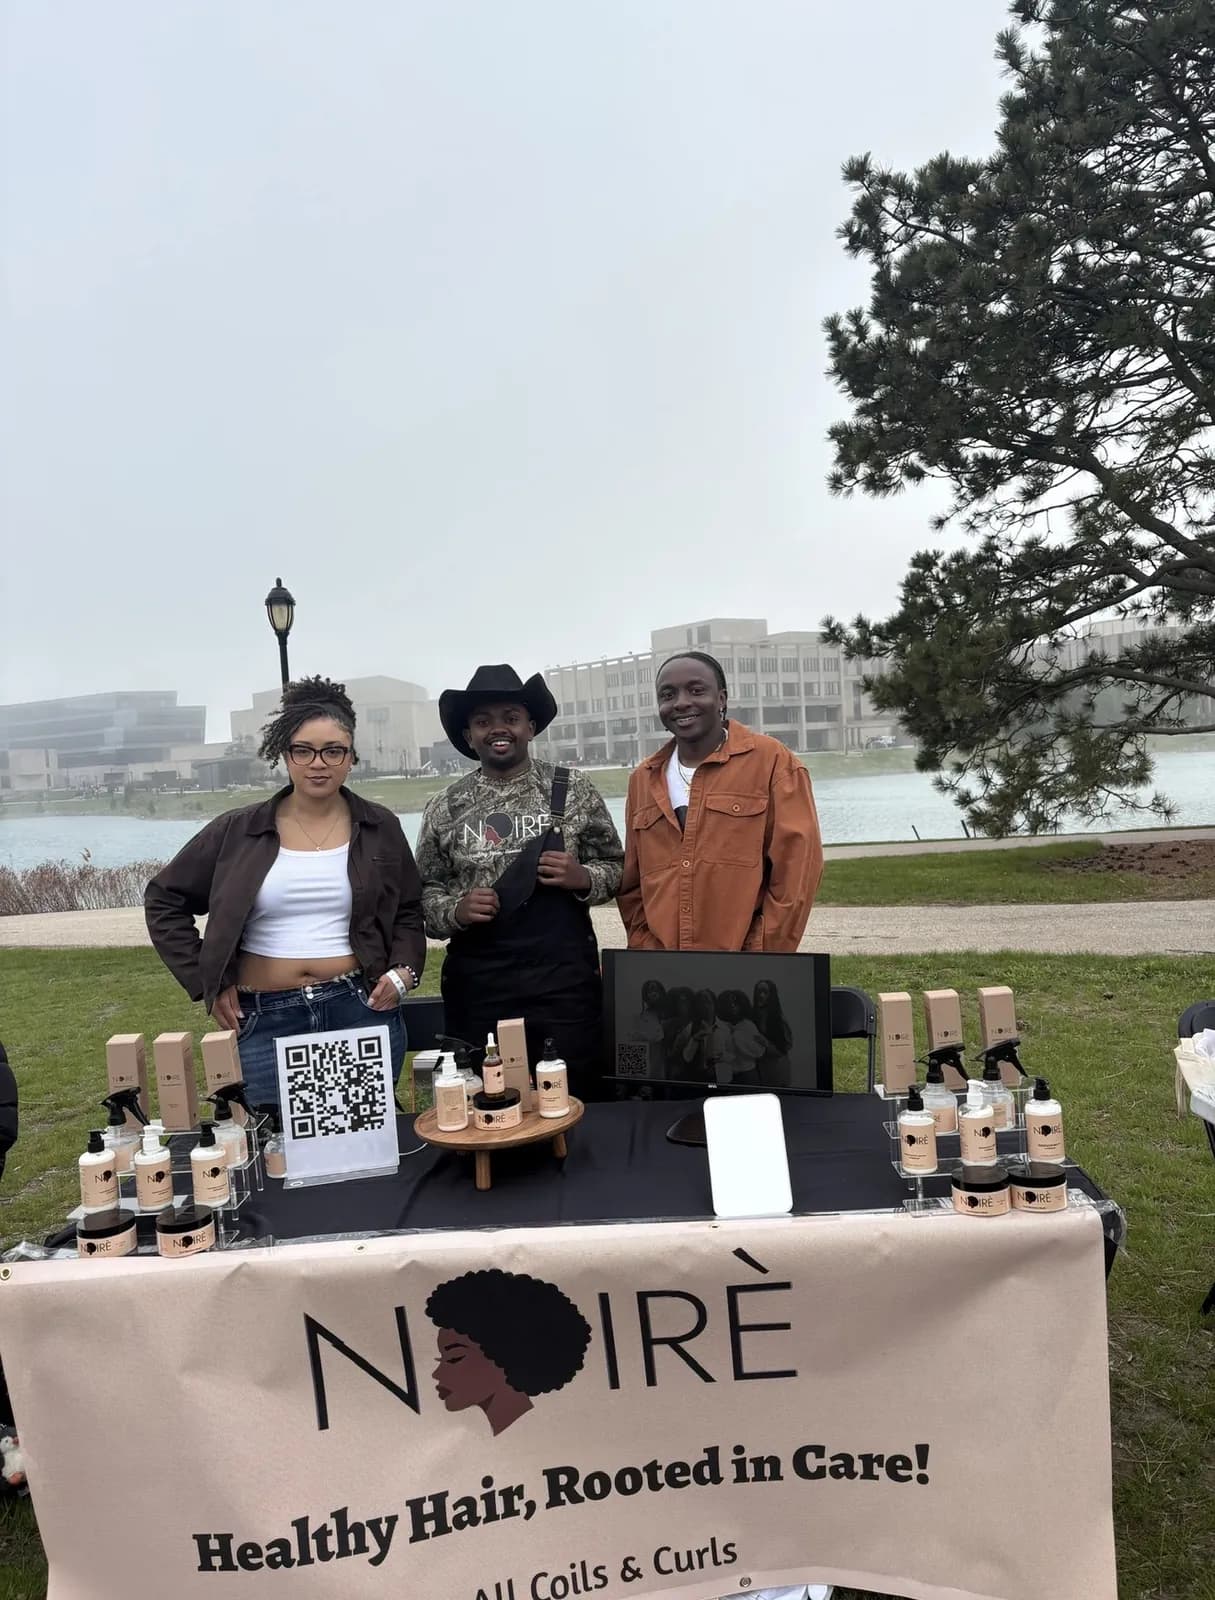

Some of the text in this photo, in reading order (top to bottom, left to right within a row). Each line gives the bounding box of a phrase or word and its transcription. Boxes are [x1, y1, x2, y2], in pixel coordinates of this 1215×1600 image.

[192, 1443, 930, 1572] Healthy Hair, Rooted in Care!
[530, 1560, 609, 1600] Coils
[620, 1556, 644, 1583] &
[653, 1536, 738, 1576] Curls
